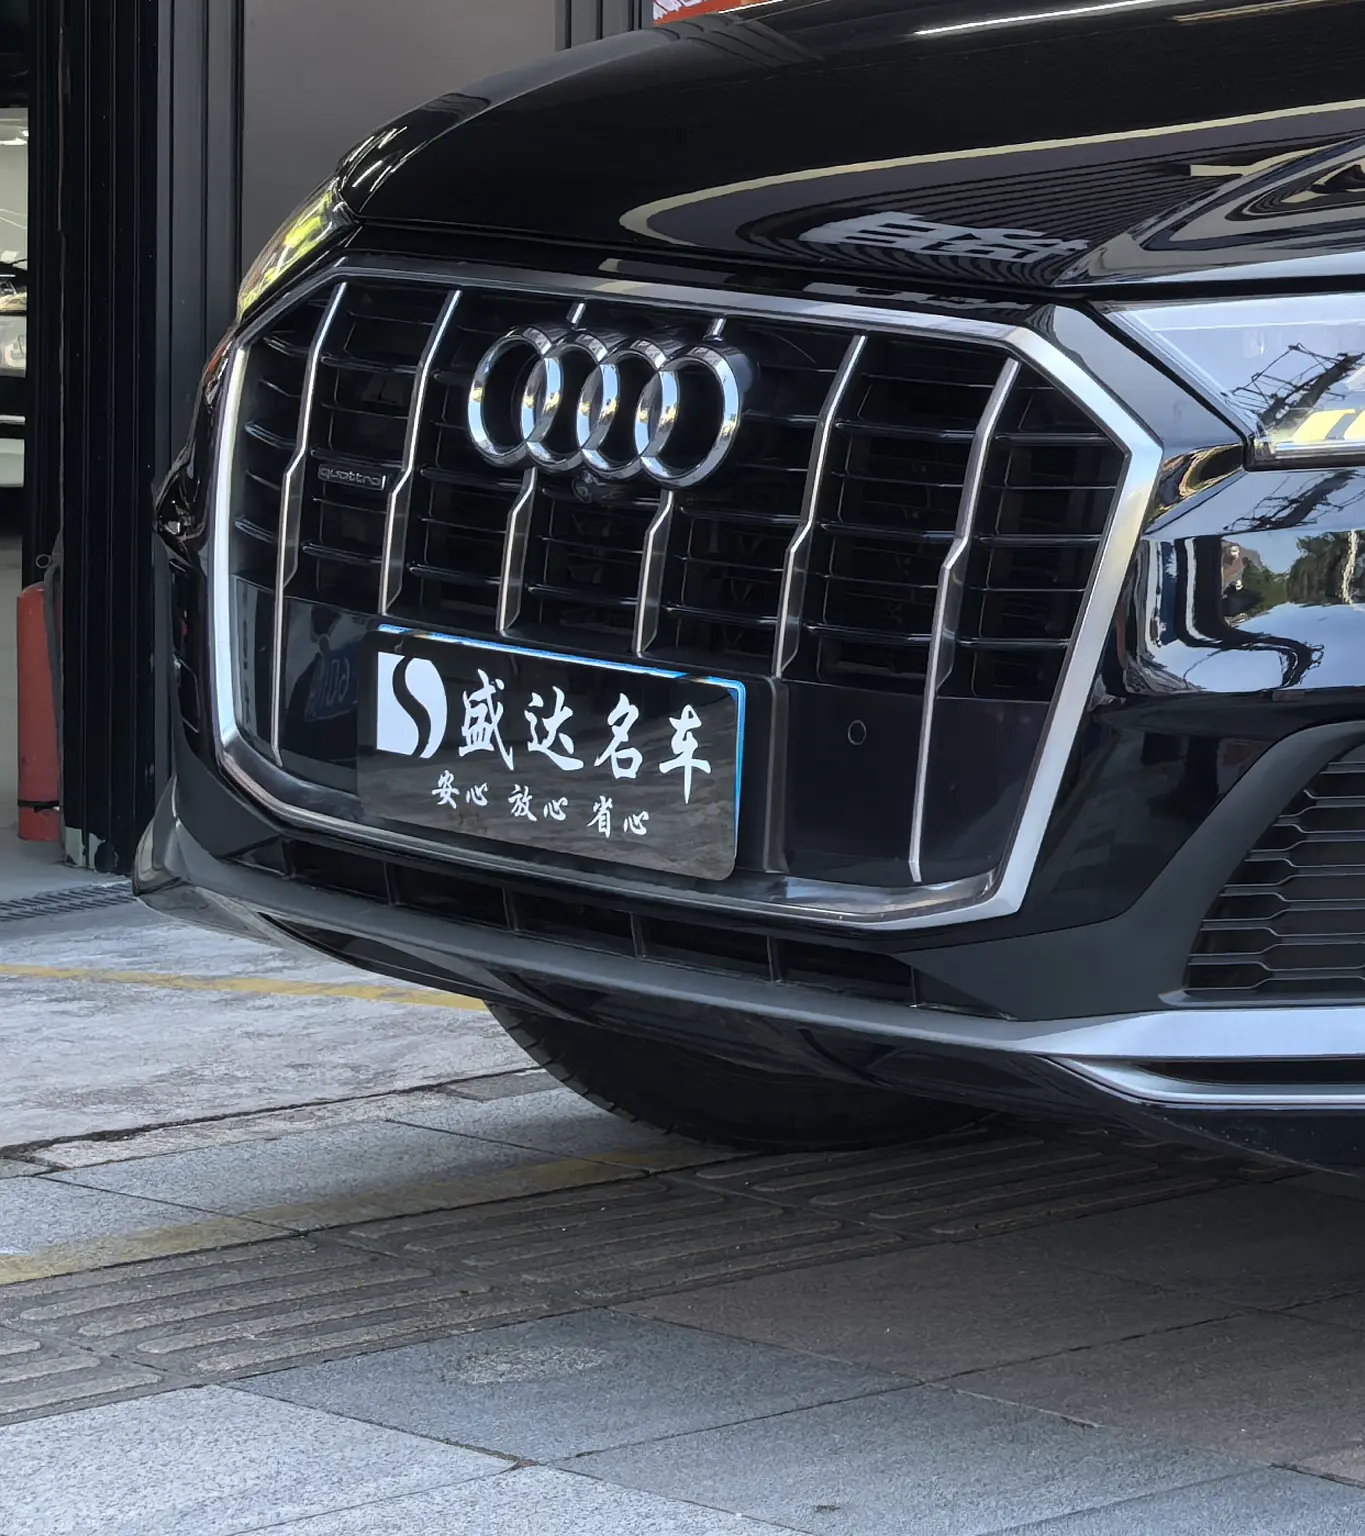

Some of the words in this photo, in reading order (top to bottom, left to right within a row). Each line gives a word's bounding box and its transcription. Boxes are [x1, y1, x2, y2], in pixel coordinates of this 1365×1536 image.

[320, 468, 380, 486] quattro
[458, 668, 711, 805] 盛达名车
[432, 770, 489, 809] 安心
[508, 784, 568, 822] 放心
[587, 796, 649, 839] 省心
